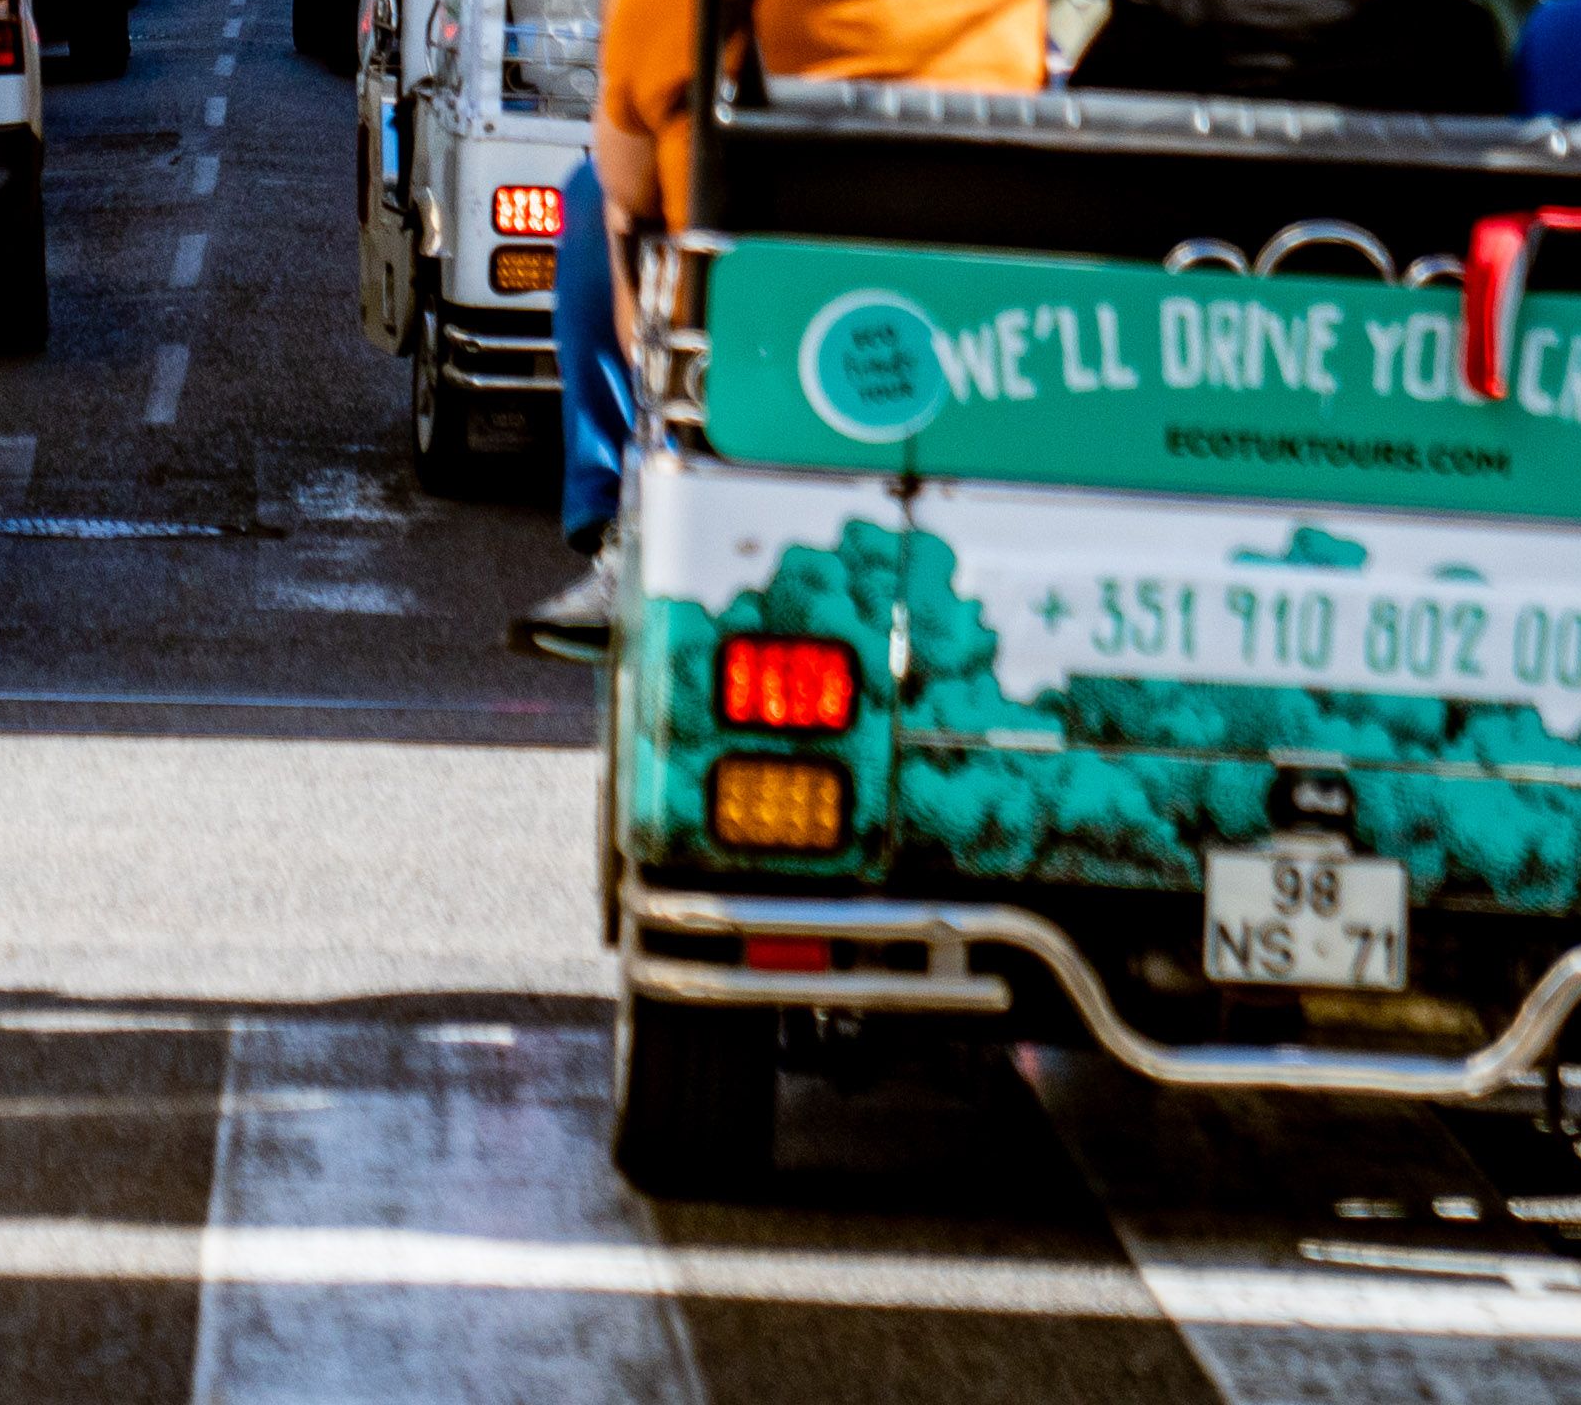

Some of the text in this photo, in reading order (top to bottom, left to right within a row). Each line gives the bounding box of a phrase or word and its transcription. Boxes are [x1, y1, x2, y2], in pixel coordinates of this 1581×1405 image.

[1159, 296, 1346, 395] DRIVE
[1364, 312, 1493, 406] YO
[1226, 586, 1335, 669] 910
[1364, 596, 1488, 679] 802
[1272, 857, 1342, 919] 98
[1209, 919, 1401, 984] NS 71
